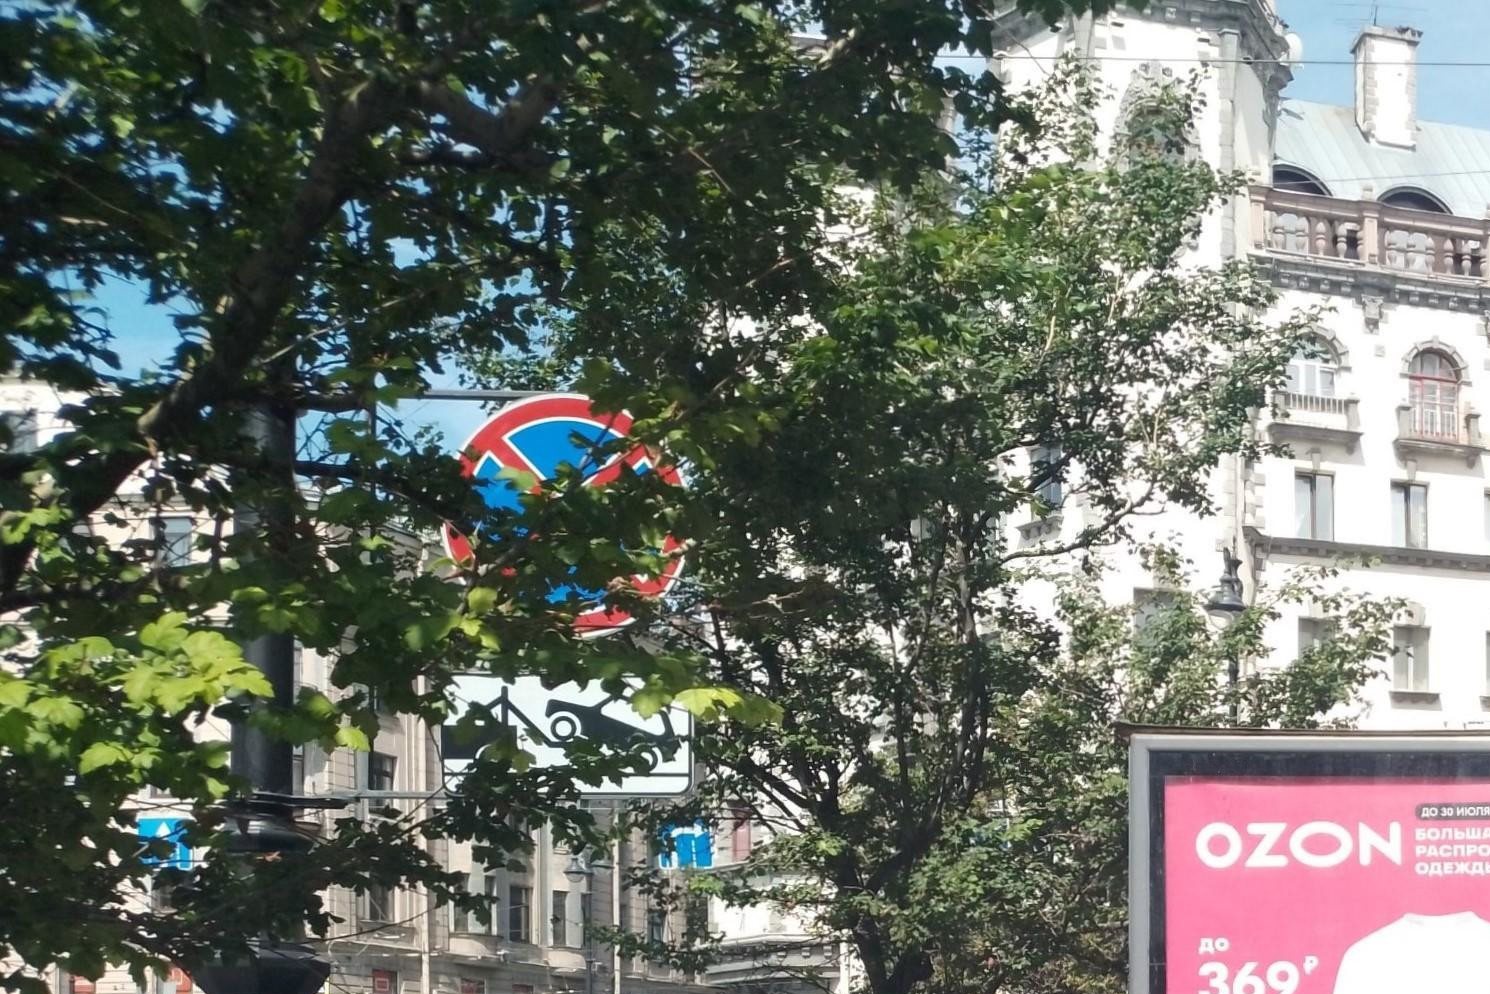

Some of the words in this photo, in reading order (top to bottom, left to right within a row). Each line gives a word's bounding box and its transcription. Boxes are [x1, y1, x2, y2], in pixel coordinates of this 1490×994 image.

[1421, 808, 1438, 819] ДО
[1440, 807, 1453, 817] 30
[1456, 806, 1490, 817] ИЮЛЯ
[1195, 821, 1402, 868] OZON
[1198, 937, 1230, 955] до
